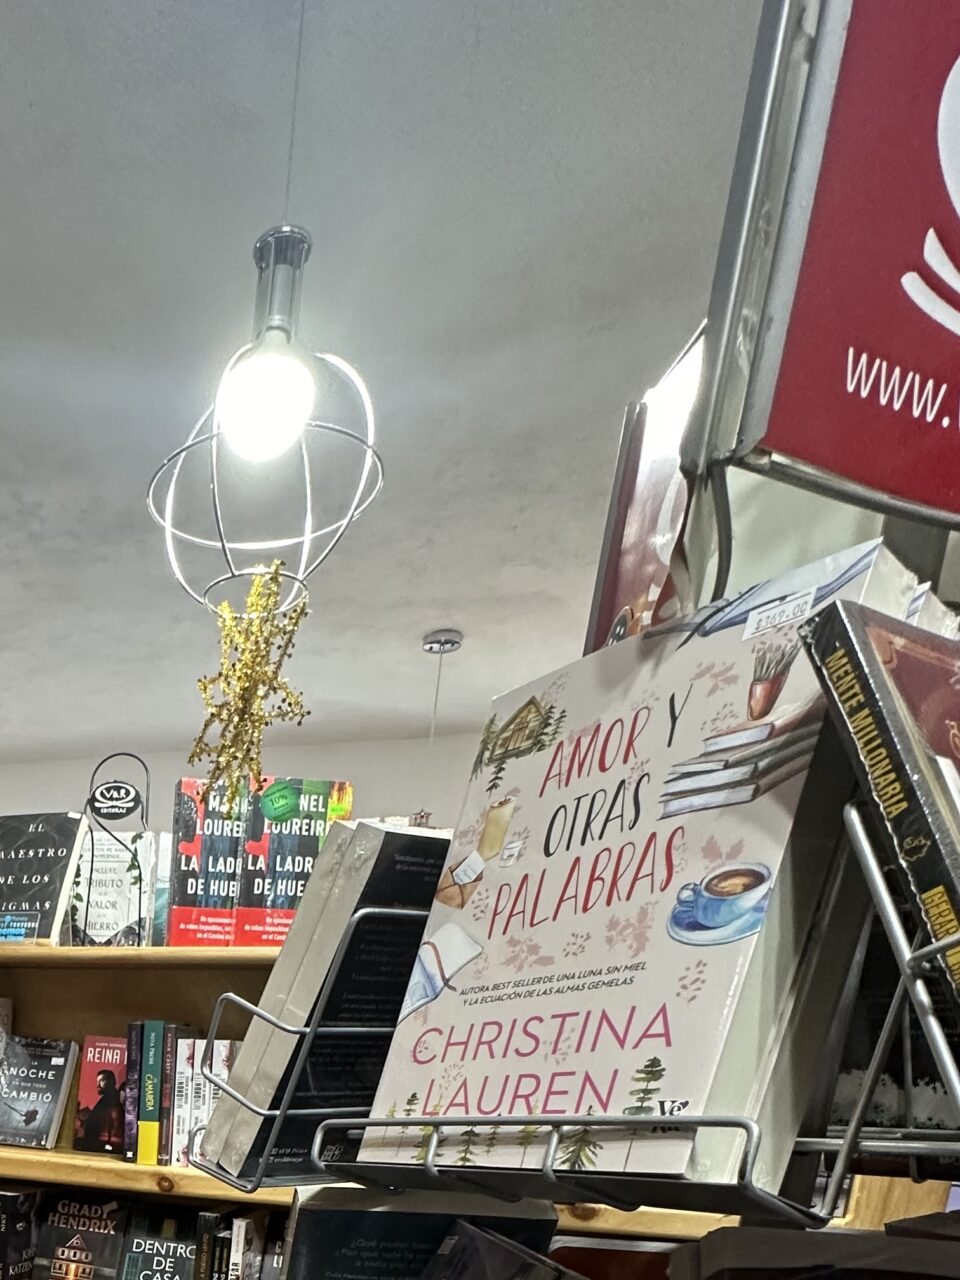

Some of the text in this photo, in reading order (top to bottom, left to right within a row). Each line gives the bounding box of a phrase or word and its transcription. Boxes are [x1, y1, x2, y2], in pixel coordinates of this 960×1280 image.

[539, 683, 694, 798] AMOR Y
[825, 648, 909, 819] MENTE MILLONARIA
[543, 772, 652, 858] OTRAS
[29, 823, 45, 833] EL
[247, 854, 266, 872] LA
[22, 874, 51, 885] LOS
[187, 878, 204, 895] DE
[254, 879, 271, 895] DE
[488, 826, 685, 941] PALABRAS
[491, 981, 512, 991] BEST
[513, 978, 542, 988] SELLER
[557, 973, 576, 982] UNA
[577, 969, 603, 978] LUNA
[605, 965, 621, 975] SIN
[622, 961, 647, 973] MIEL
[480, 976, 635, 1004] ECUACIÓN LAS ALMAS GEMELAS
[411, 1001, 673, 1065] CHRISTINA
[87, 1047, 120, 1064] REINA
[1, 1089, 52, 1102] CAMBIÓ
[422, 1068, 619, 1117] LAUREN
[57, 1199, 119, 1219] GRADY
[47, 1212, 117, 1235] HENDRIX
[152, 1257, 174, 1272] DE
